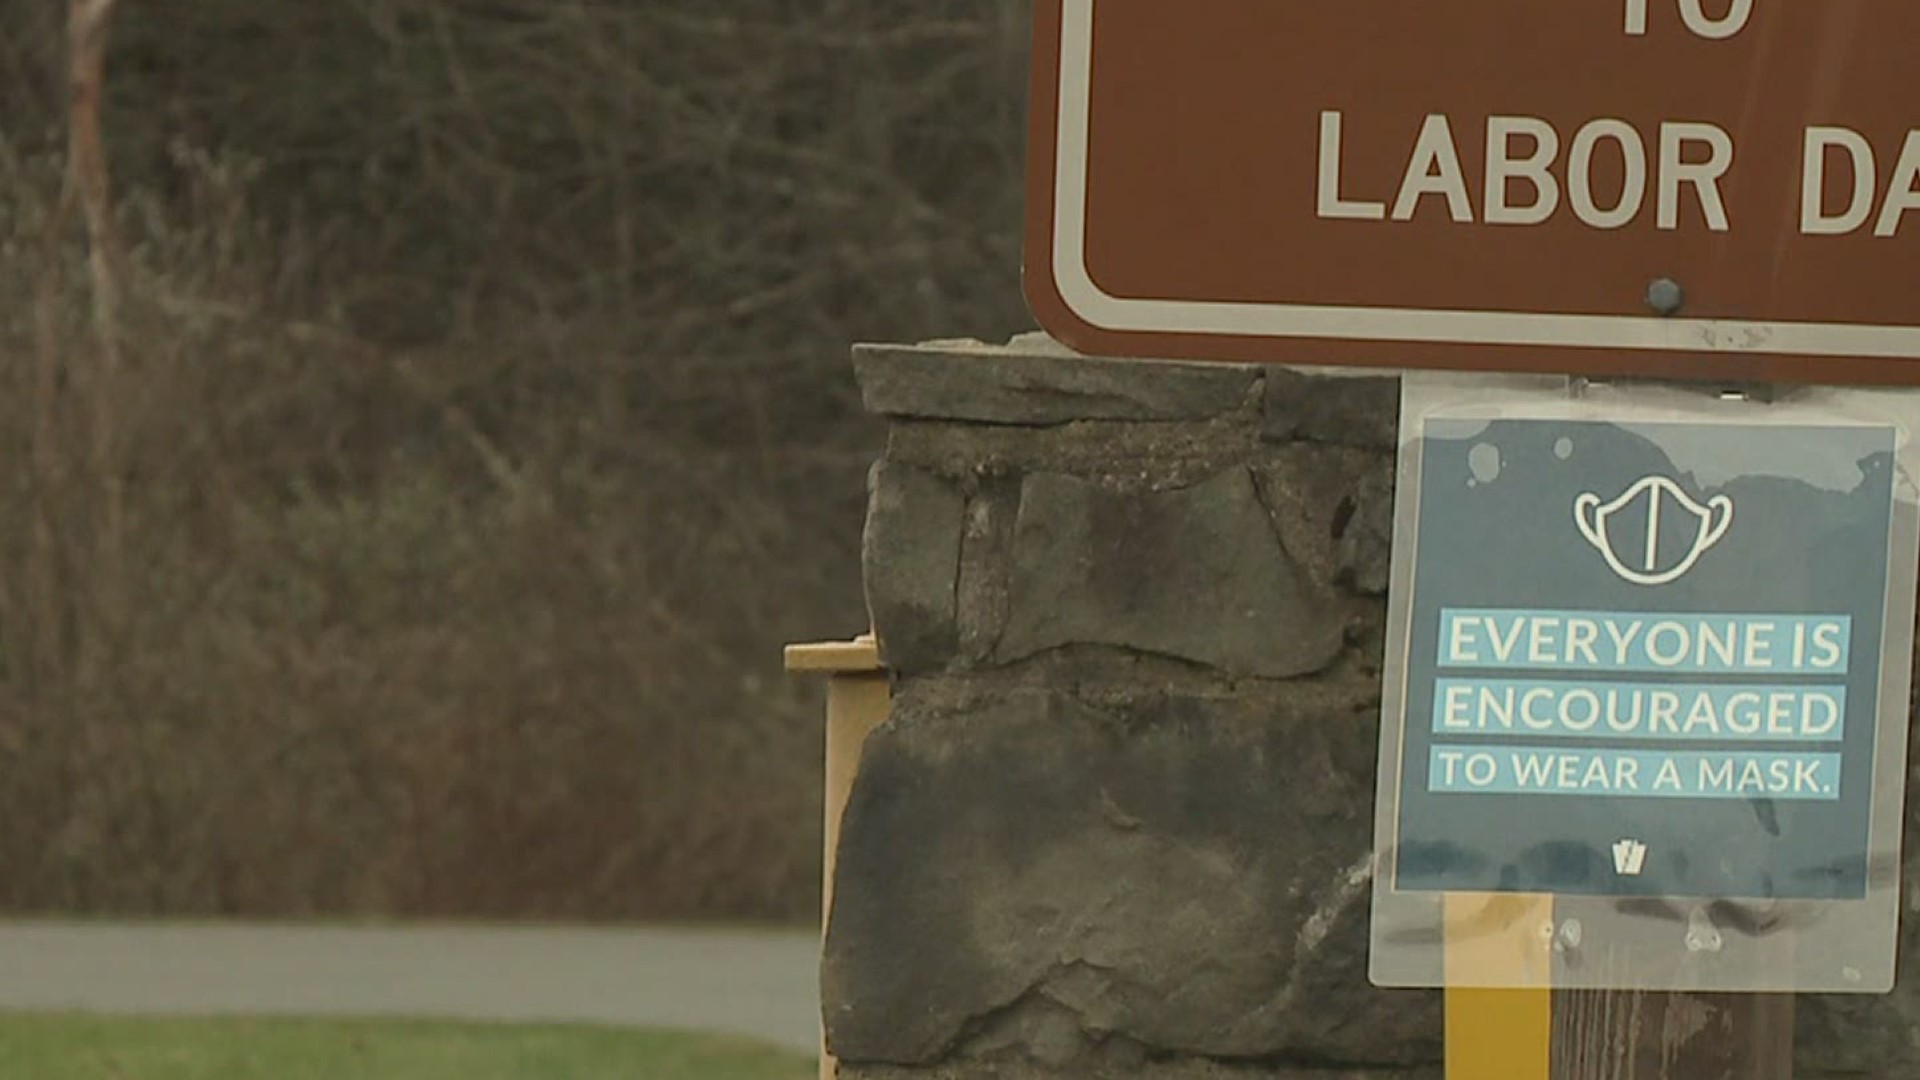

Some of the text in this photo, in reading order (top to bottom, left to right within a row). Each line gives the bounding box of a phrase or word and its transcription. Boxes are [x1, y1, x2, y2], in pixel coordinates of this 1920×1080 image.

[1316, 110, 1734, 231] LABOR
[1449, 616, 1842, 668] EVERYONE IS
[1444, 685, 1838, 735] ENCOURAGED
[1439, 753, 1832, 793] TO WEAR A MASK.
